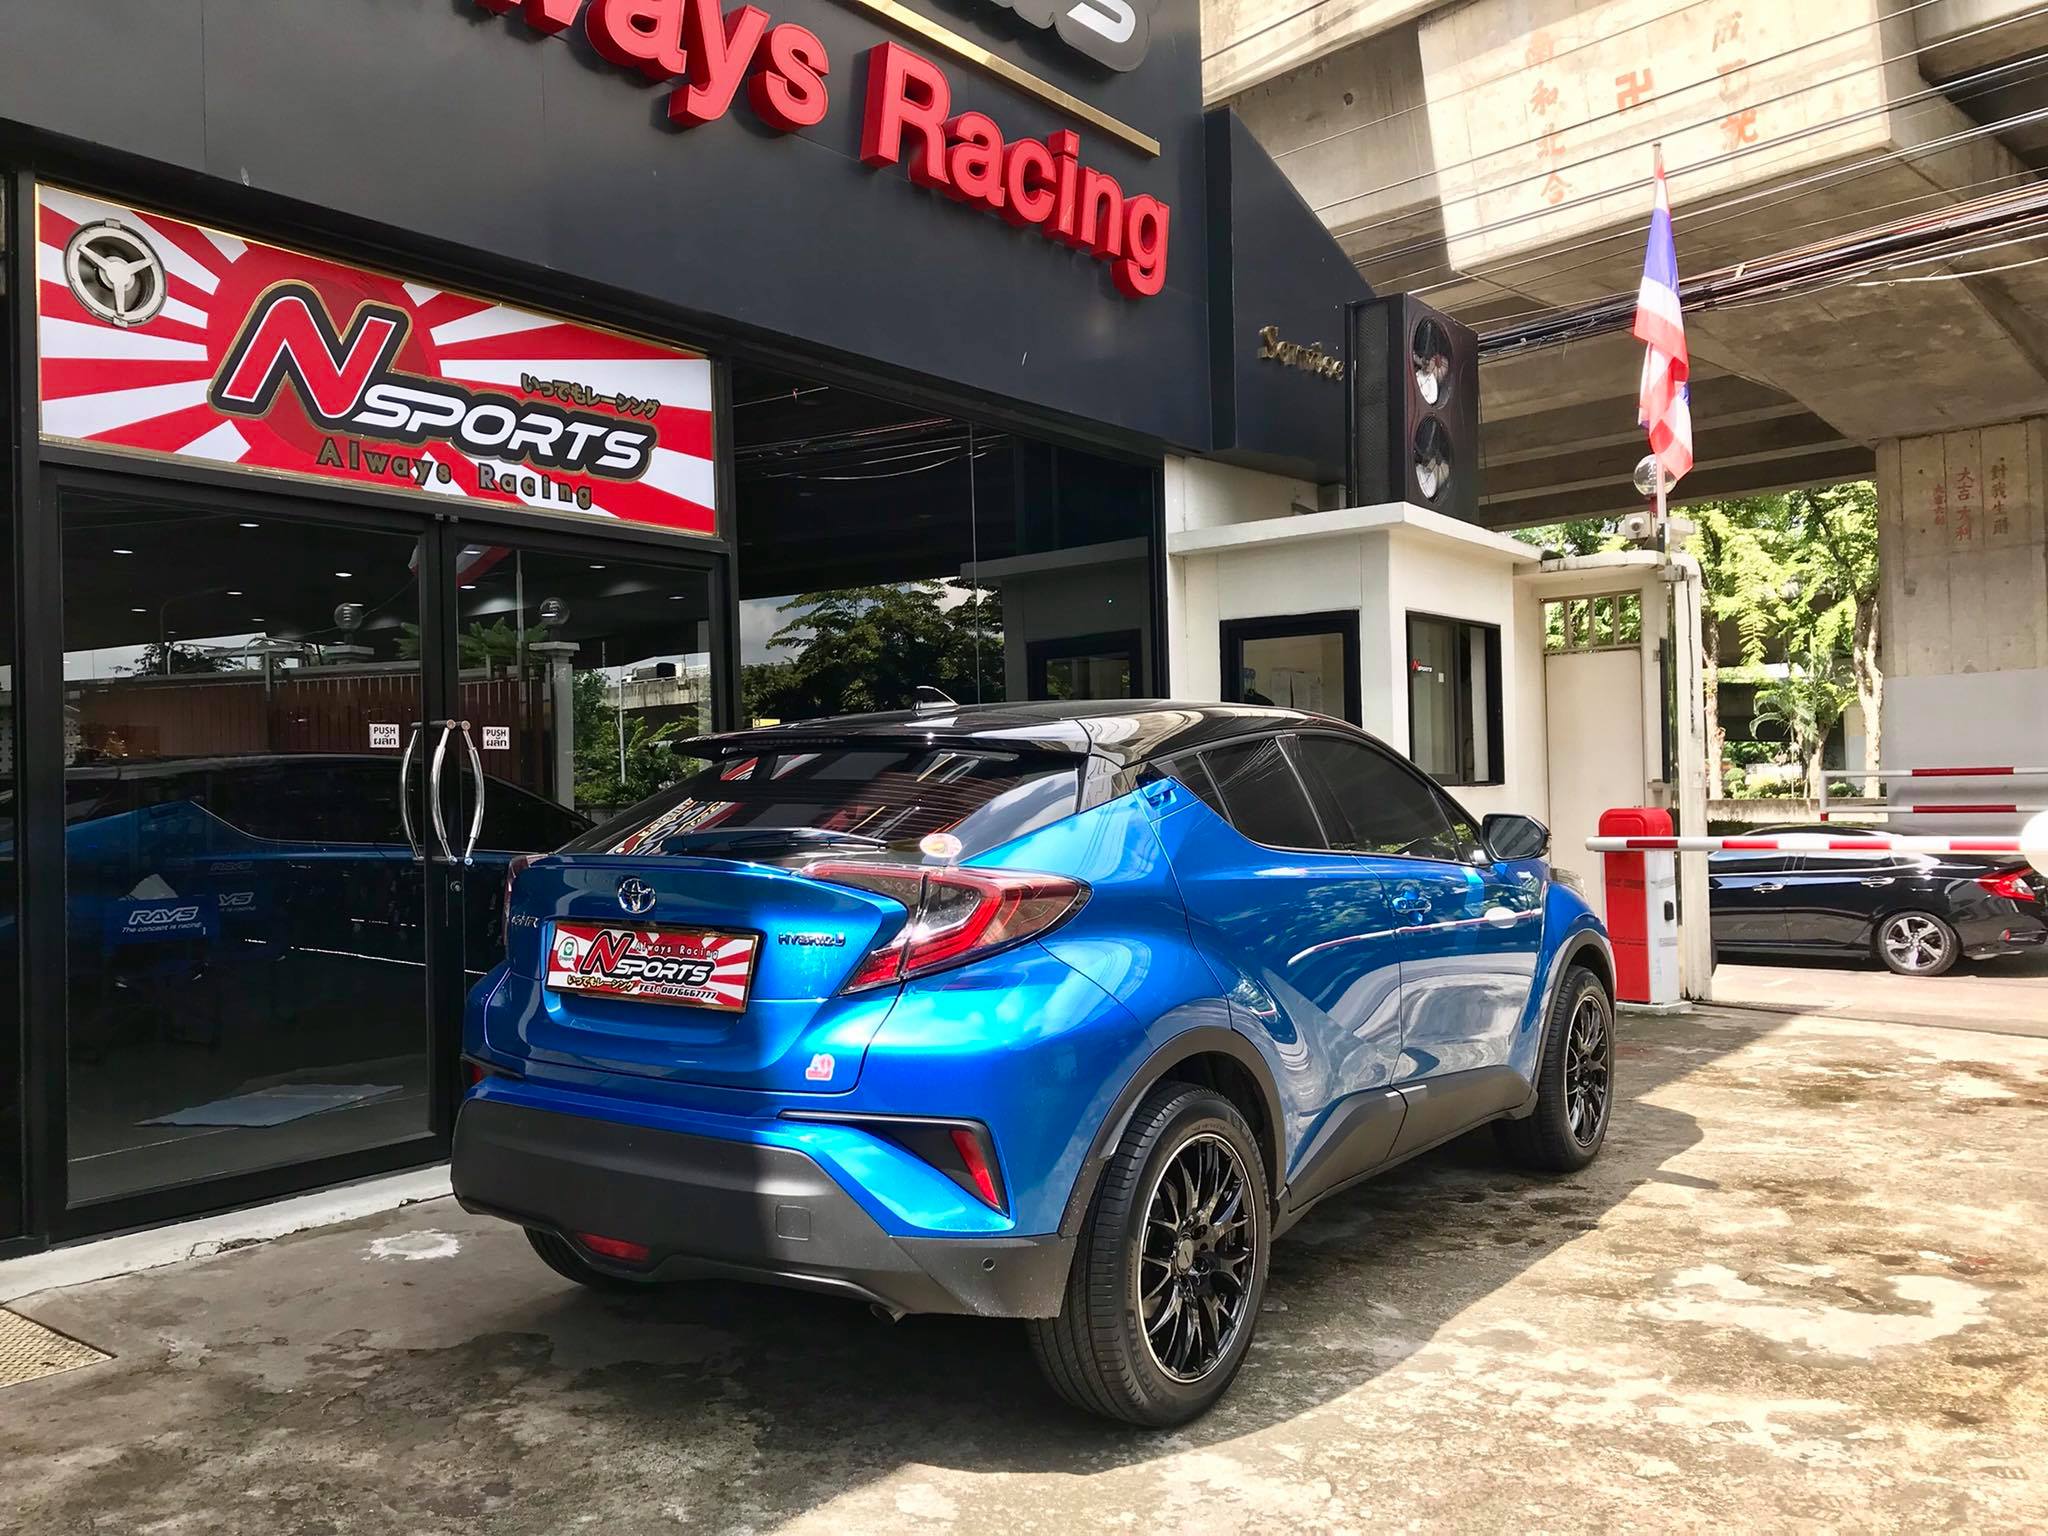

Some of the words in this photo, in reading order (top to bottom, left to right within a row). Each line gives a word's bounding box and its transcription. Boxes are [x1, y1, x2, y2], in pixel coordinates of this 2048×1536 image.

[859, 40, 1171, 299] Racing
[316, 437, 452, 486] Always
[478, 462, 592, 510] Racing
[373, 726, 396, 735] PUSH
[486, 729, 507, 737] PUSH
[373, 735, 397, 746] ผลัก
[486, 737, 507, 747] ผลัก
[128, 906, 199, 925] RAYS
[679, 945, 719, 959] Racing
